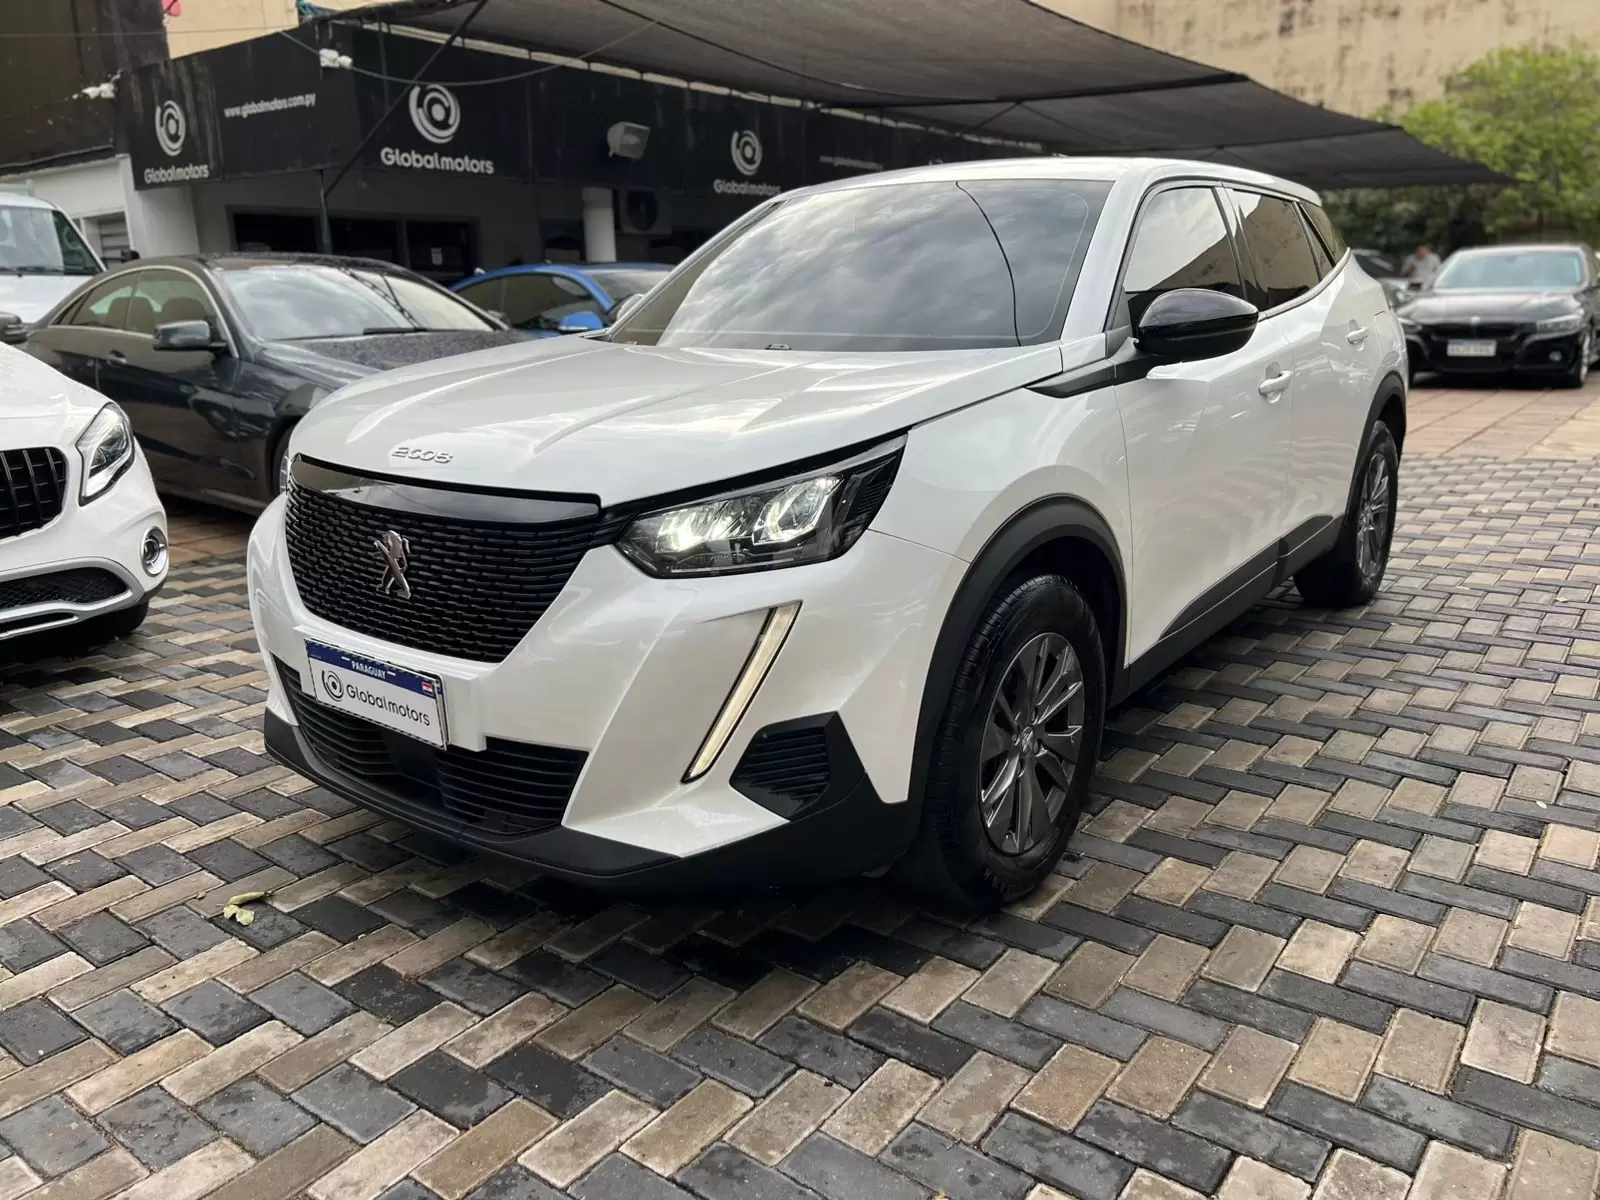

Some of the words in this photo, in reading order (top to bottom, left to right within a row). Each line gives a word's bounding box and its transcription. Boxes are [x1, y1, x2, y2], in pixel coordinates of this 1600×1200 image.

[380, 147, 494, 174] Globalmotors
[144, 163, 210, 184] Globalmotors
[713, 178, 781, 196] Globalmotors
[390, 446, 454, 465] 2008
[351, 660, 386, 680] PARAGUAY
[346, 684, 431, 726] Globalmotors
